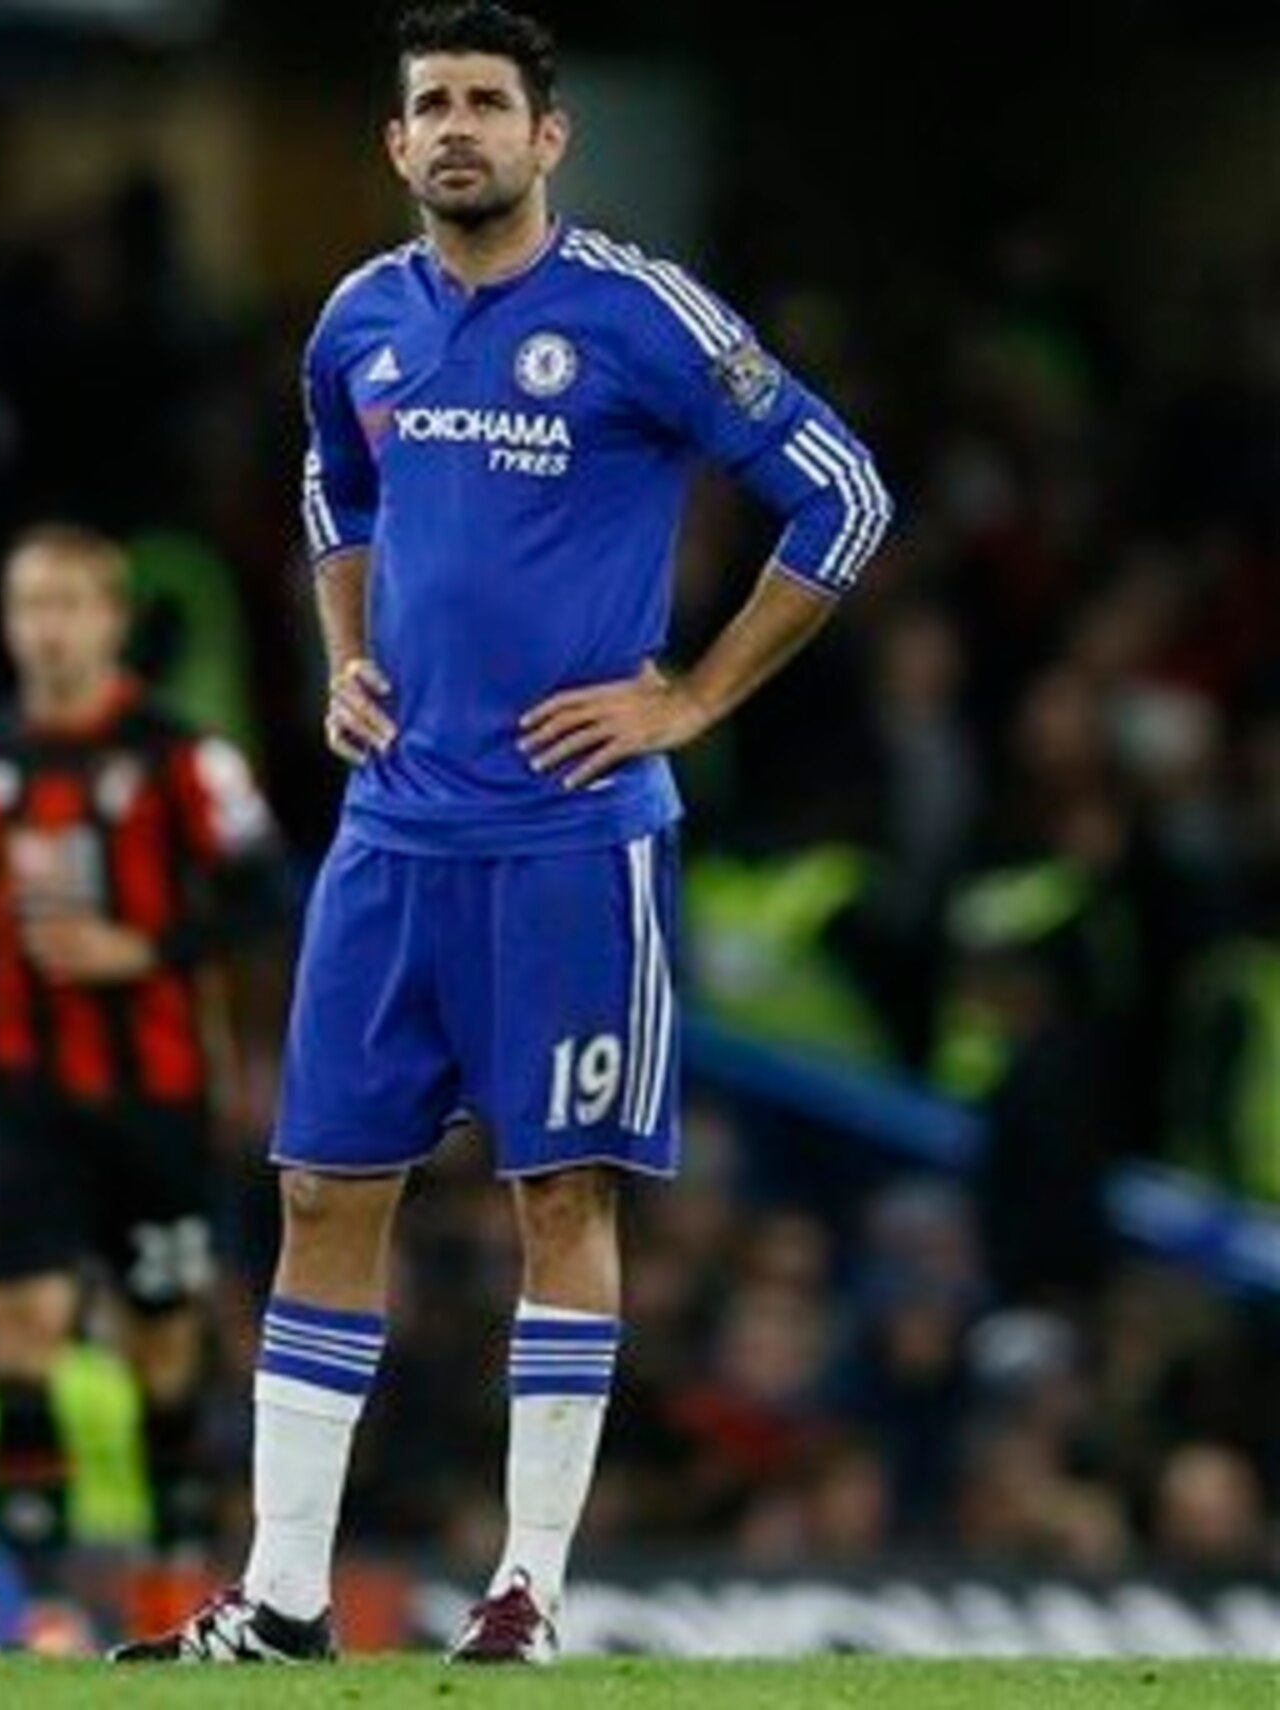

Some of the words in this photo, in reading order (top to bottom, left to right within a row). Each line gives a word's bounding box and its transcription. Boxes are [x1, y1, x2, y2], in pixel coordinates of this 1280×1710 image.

[394, 407, 572, 448] YOKOHAMA
[489, 449, 568, 476] TYRES
[546, 1034, 621, 1131] 19
